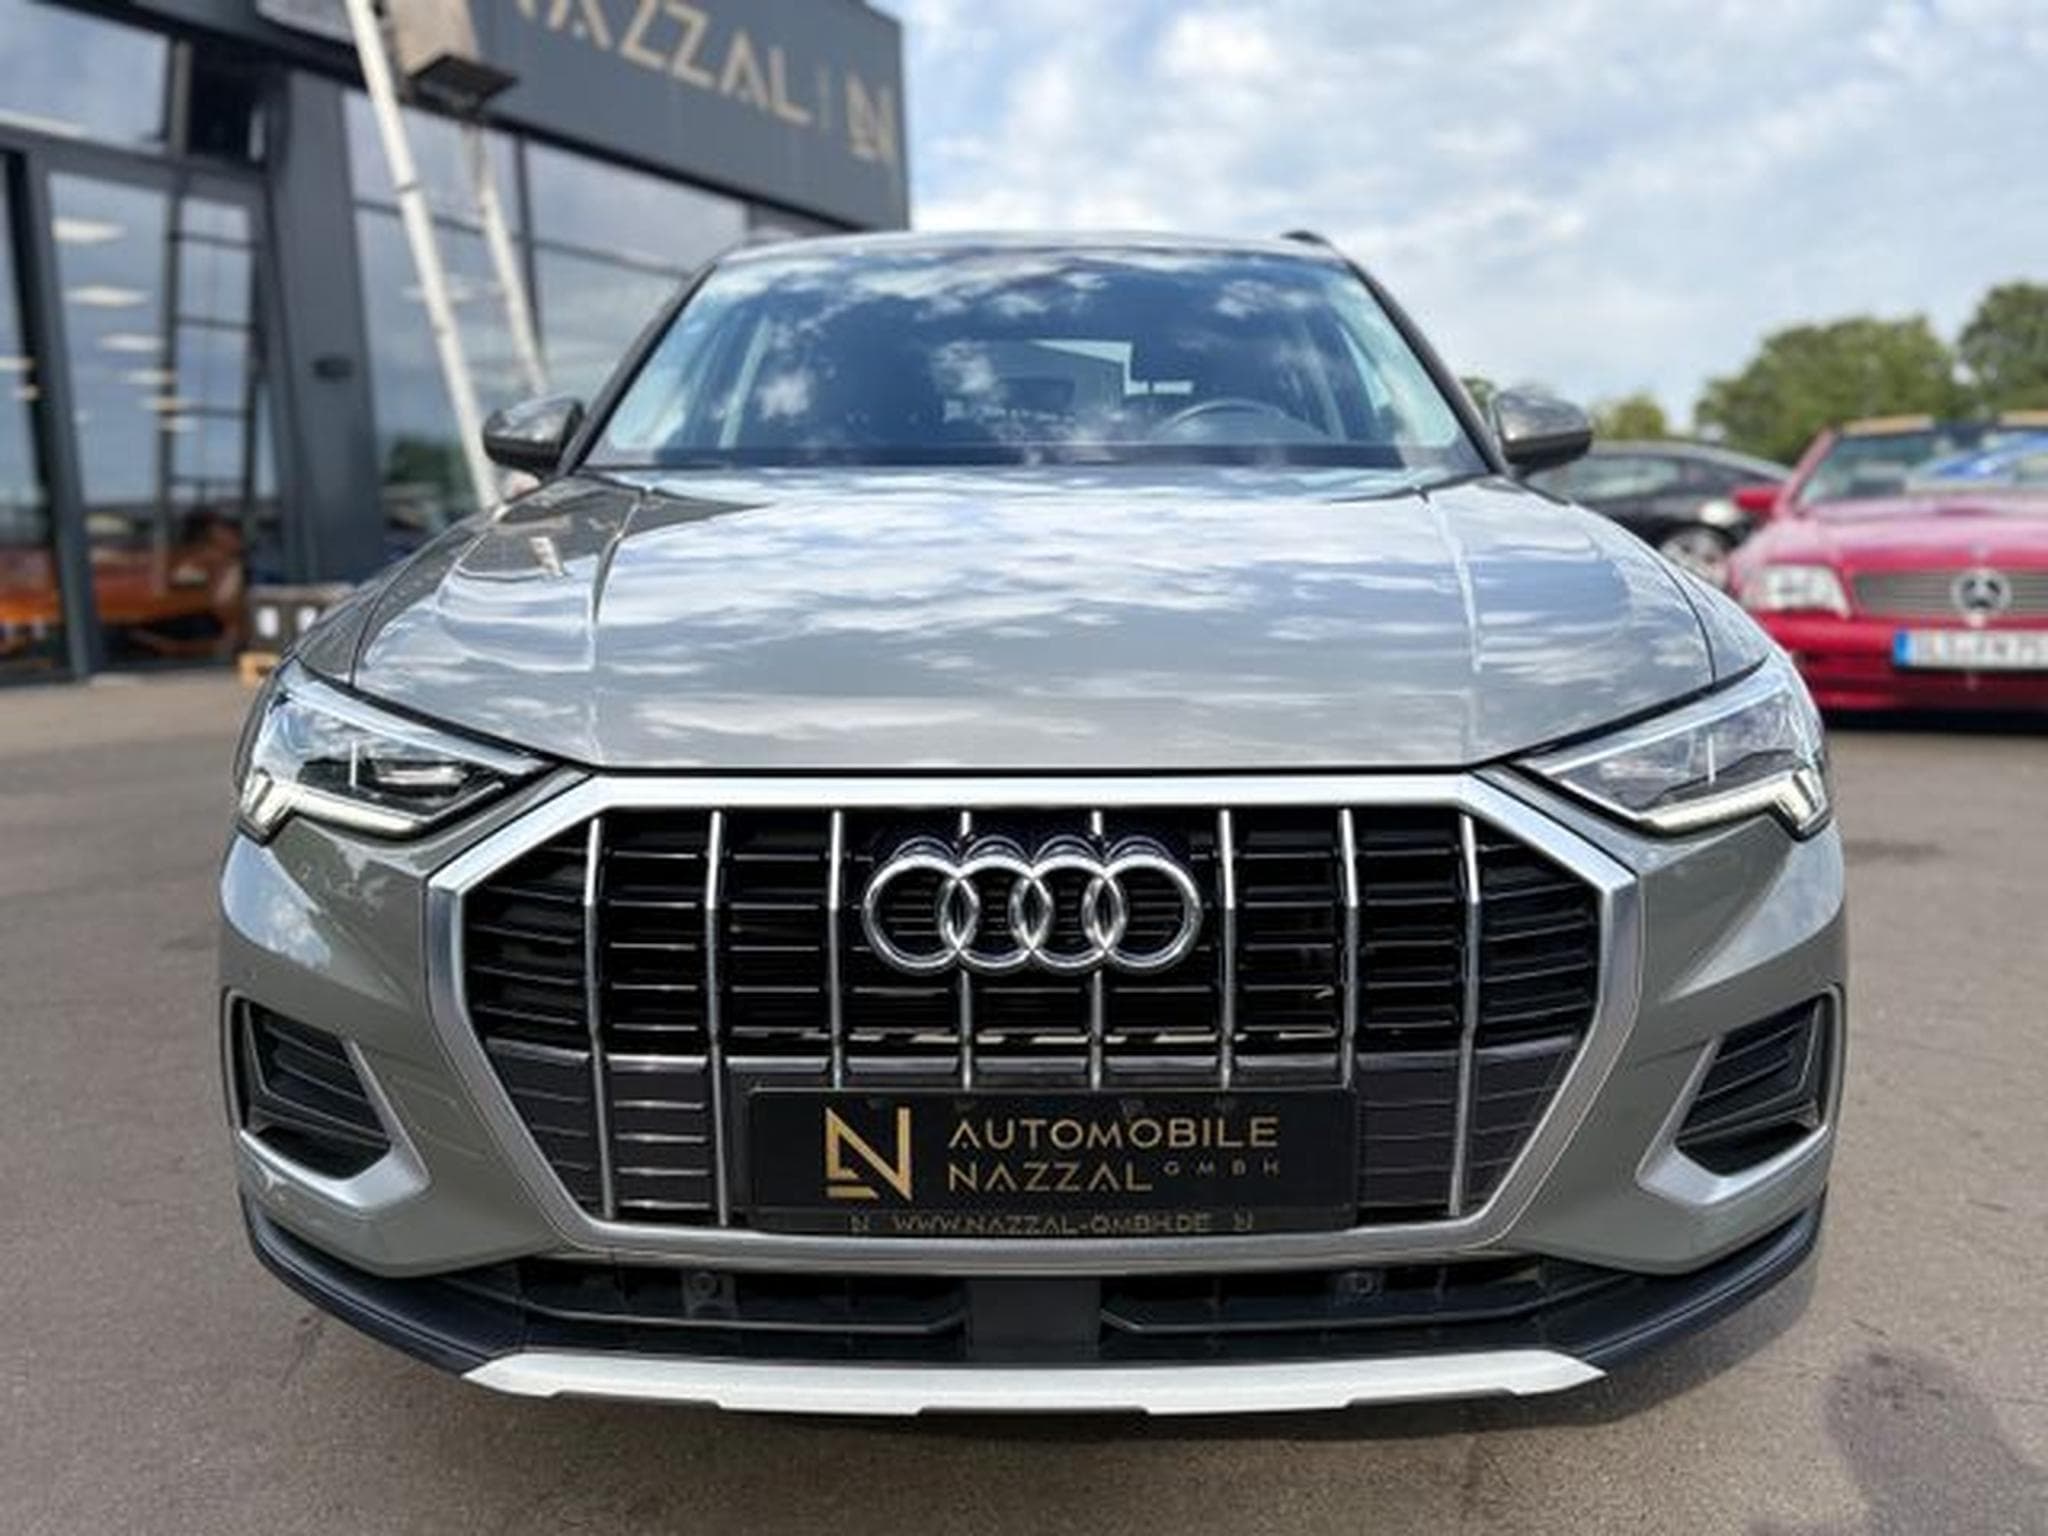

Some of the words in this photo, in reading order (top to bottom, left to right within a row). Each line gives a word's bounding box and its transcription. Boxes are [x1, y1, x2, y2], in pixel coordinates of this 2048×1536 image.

[513, 0, 813, 127] AZZAL
[948, 1116, 1280, 1149] AUTOMOBILE
[948, 1160, 1153, 1192] NAZZAL
[1163, 1160, 1281, 1177] GMBH
